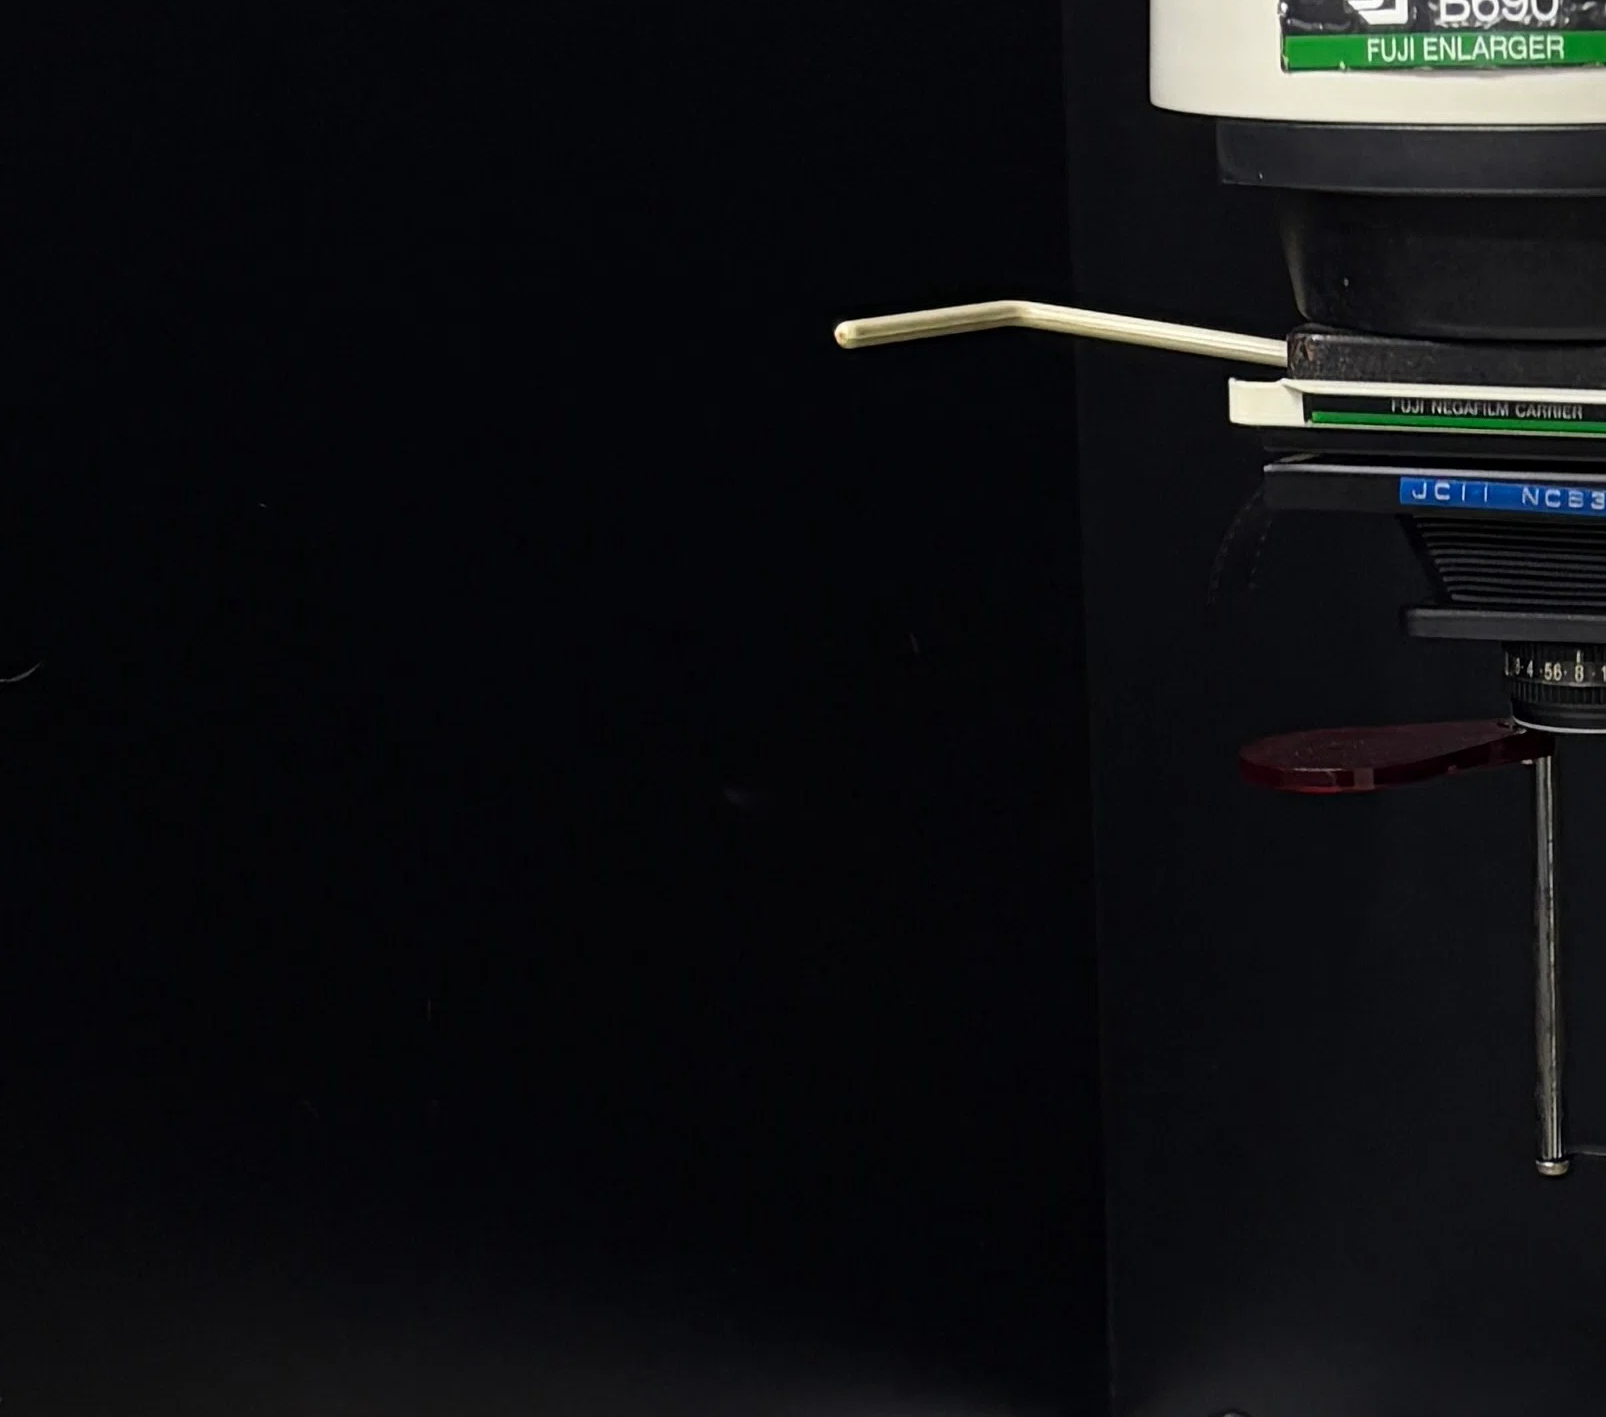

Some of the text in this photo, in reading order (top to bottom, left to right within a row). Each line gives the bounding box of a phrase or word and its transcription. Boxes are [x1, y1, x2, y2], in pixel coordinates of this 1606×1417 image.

[1366, 35, 1565, 63] FUJI ENLARGER
[1391, 398, 1425, 414] FUJI
[1515, 403, 1583, 420] CARRIER
[1526, 660, 1534, 678] 4
[1574, 665, 1585, 682] 8
